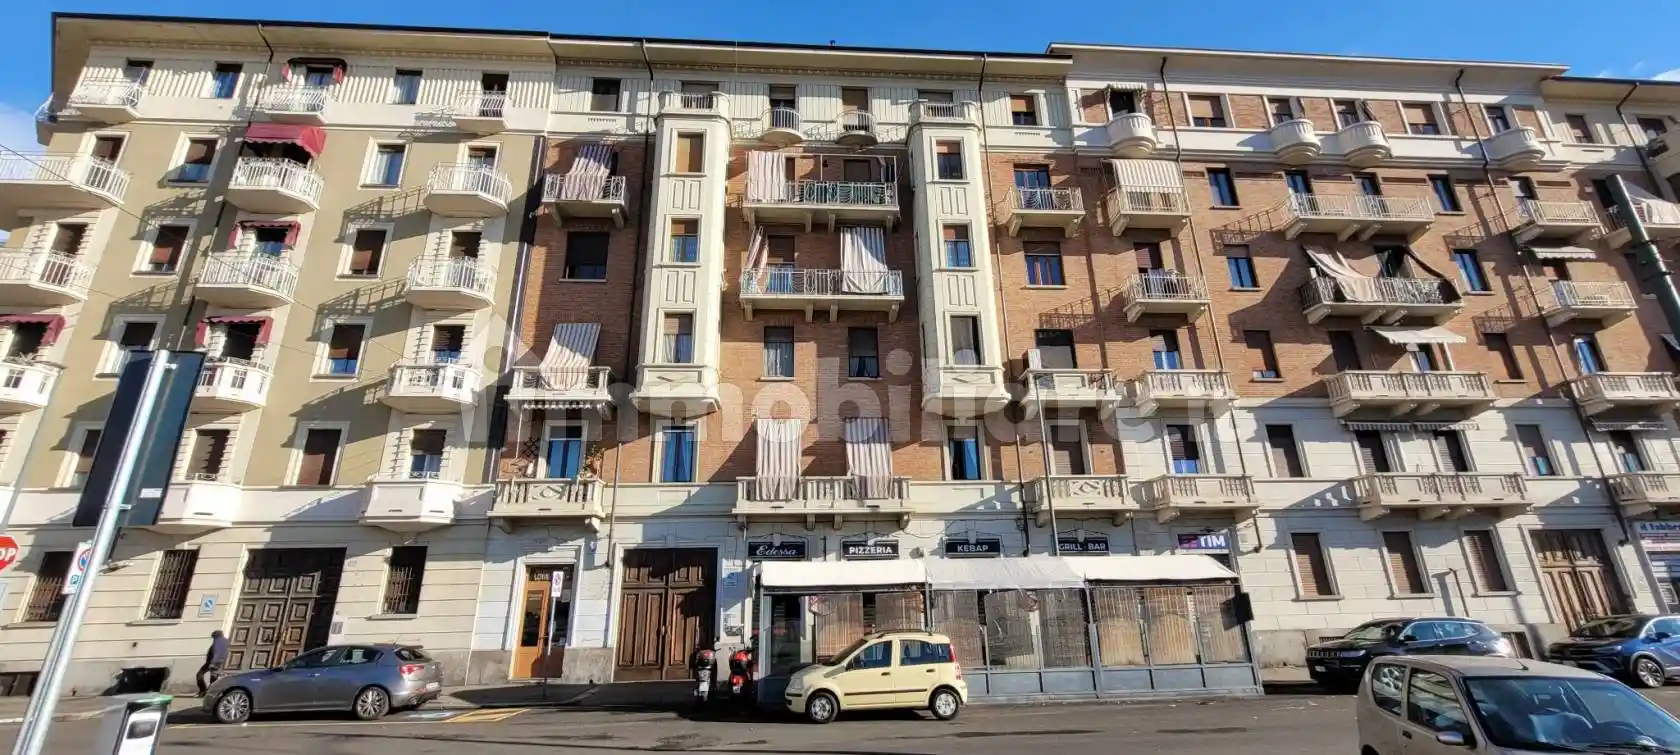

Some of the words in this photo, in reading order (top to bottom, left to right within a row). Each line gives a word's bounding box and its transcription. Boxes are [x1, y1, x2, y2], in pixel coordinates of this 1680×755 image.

[1200, 535, 1226, 547] TIM
[756, 544, 797, 556] Edessa
[848, 546, 893, 554] PIZZERIA
[957, 544, 988, 552] KEBAP
[1058, 543, 1082, 551] GRILL
[1088, 543, 1106, 551] BAR
